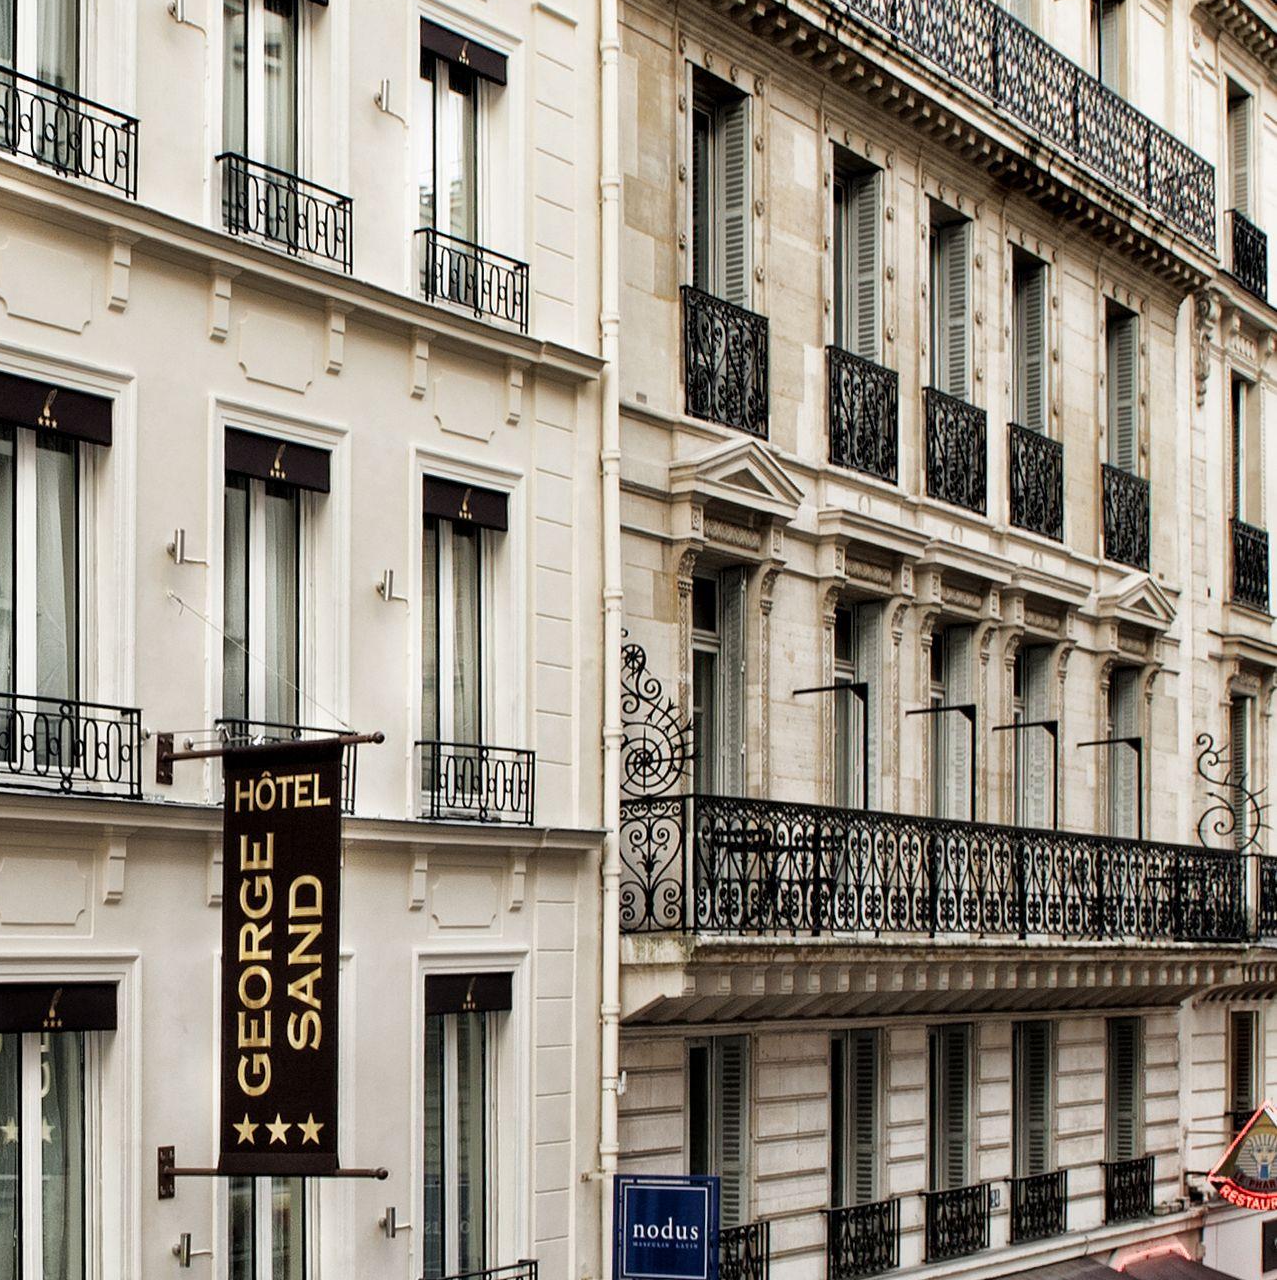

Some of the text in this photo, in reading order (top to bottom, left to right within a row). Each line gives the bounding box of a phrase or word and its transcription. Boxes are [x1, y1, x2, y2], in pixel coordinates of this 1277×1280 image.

[235, 771, 331, 813] HÔTEL
[237, 831, 275, 1097] GEORGE
[286, 874, 324, 1051] SAND
[633, 1216, 699, 1240] nodus
